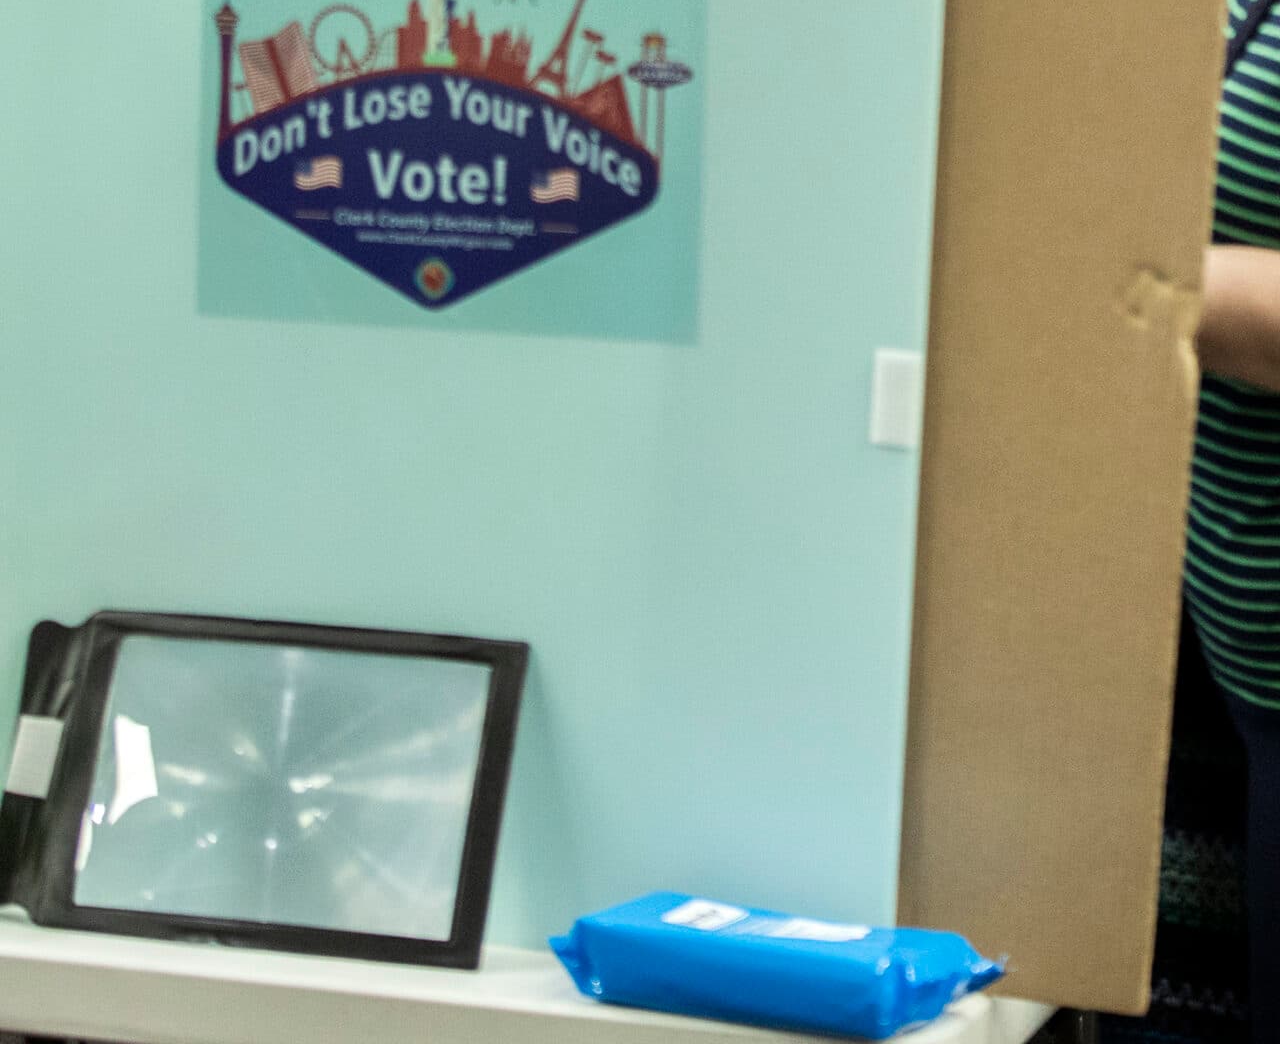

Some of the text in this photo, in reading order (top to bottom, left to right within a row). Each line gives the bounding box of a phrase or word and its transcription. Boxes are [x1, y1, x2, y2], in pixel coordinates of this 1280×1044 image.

[235, 77, 642, 197] Don't Lose Your Voice
[368, 149, 507, 205] Vote!
